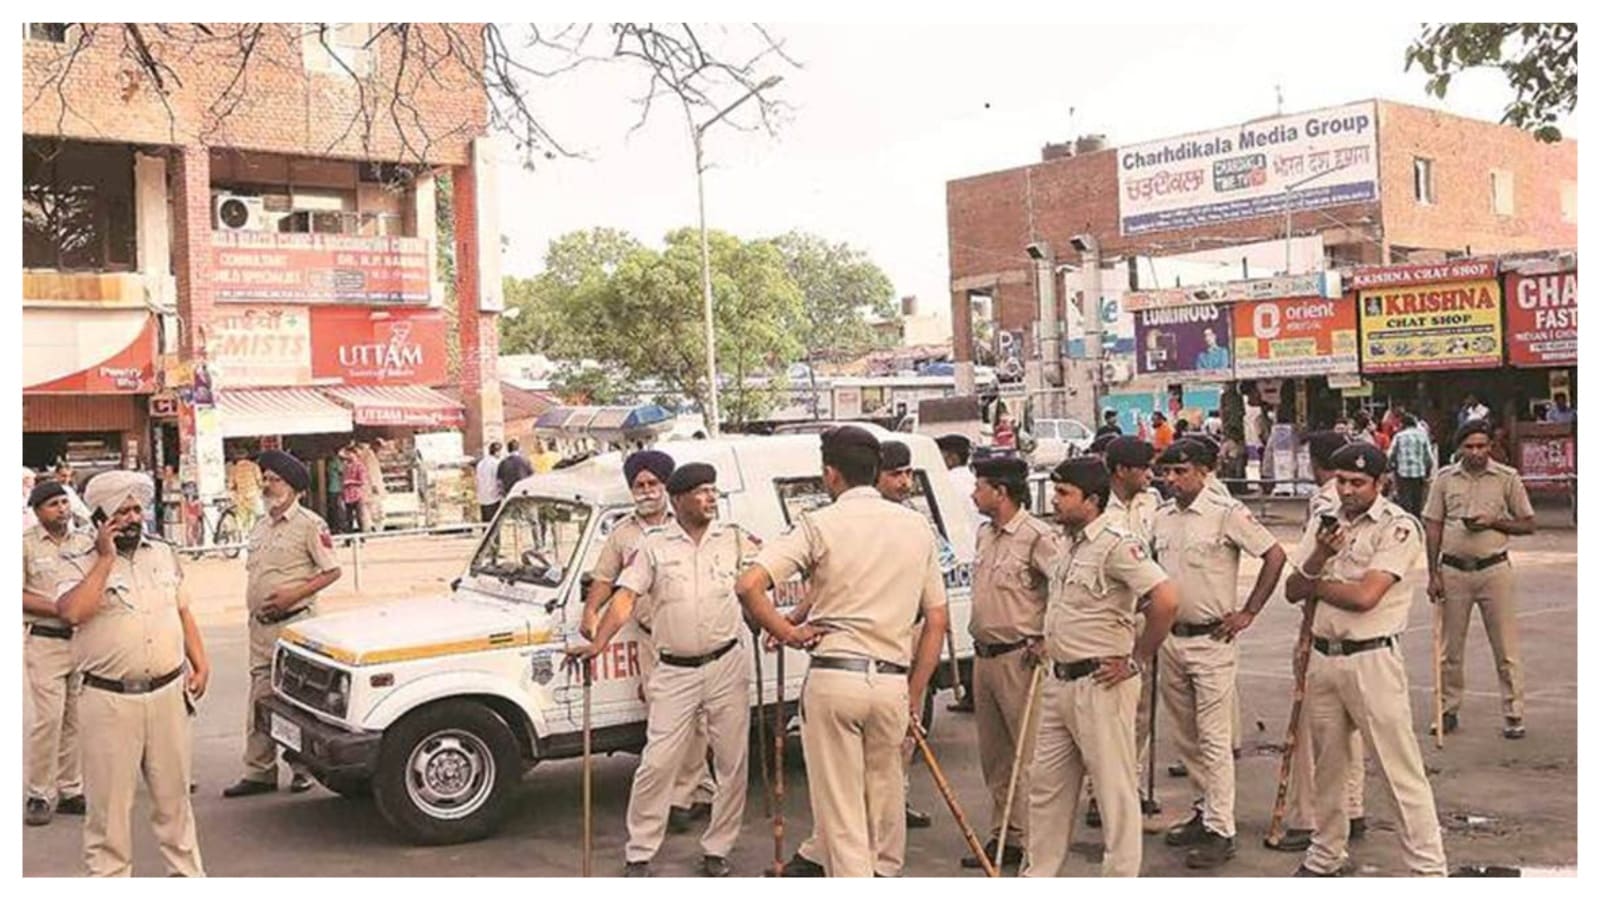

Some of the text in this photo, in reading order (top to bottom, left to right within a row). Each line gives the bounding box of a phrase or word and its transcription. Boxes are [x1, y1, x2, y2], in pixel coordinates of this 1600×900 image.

[1122, 114, 1369, 171] Charhdikala Media Group
[1355, 264, 1488, 285] KRISHNA CHAT SHOP
[1286, 301, 1335, 318] orient
[1385, 287, 1496, 315] KRISHNA
[1143, 305, 1219, 325] LUMINOUS
[1387, 314, 1472, 328] CHAT SHOP
[339, 345, 423, 367] UTTAM
[358, 408, 401, 423] UTTAM
